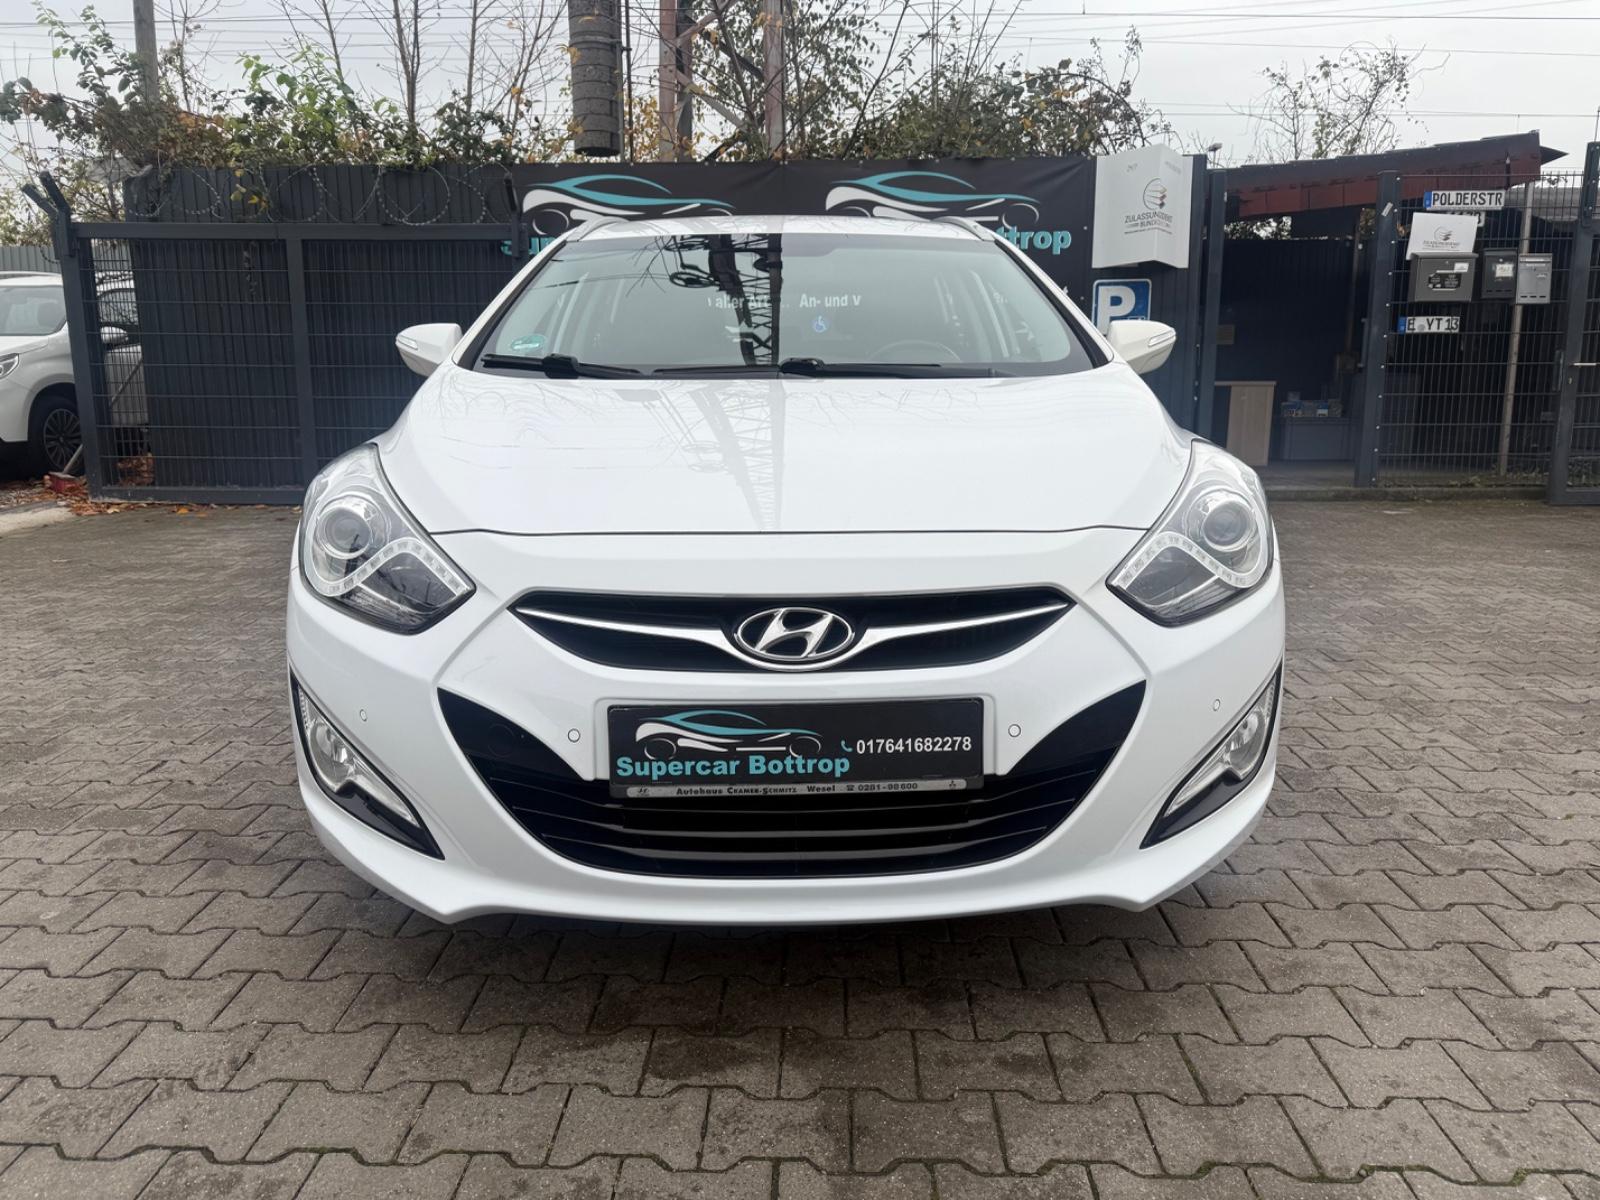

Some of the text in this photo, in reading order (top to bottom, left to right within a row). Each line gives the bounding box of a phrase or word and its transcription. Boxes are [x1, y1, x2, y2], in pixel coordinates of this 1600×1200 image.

[1432, 193, 1503, 206] POLDERSTR
[825, 294, 848, 307] und
[1097, 286, 1136, 334] P
[1407, 318, 1416, 331] E
[1426, 318, 1442, 330] YT
[856, 737, 972, 754] 017641682278
[616, 755, 850, 780] Supercar Bottrop
[676, 787, 723, 795] Autohaus
[807, 785, 836, 793] Wesel
